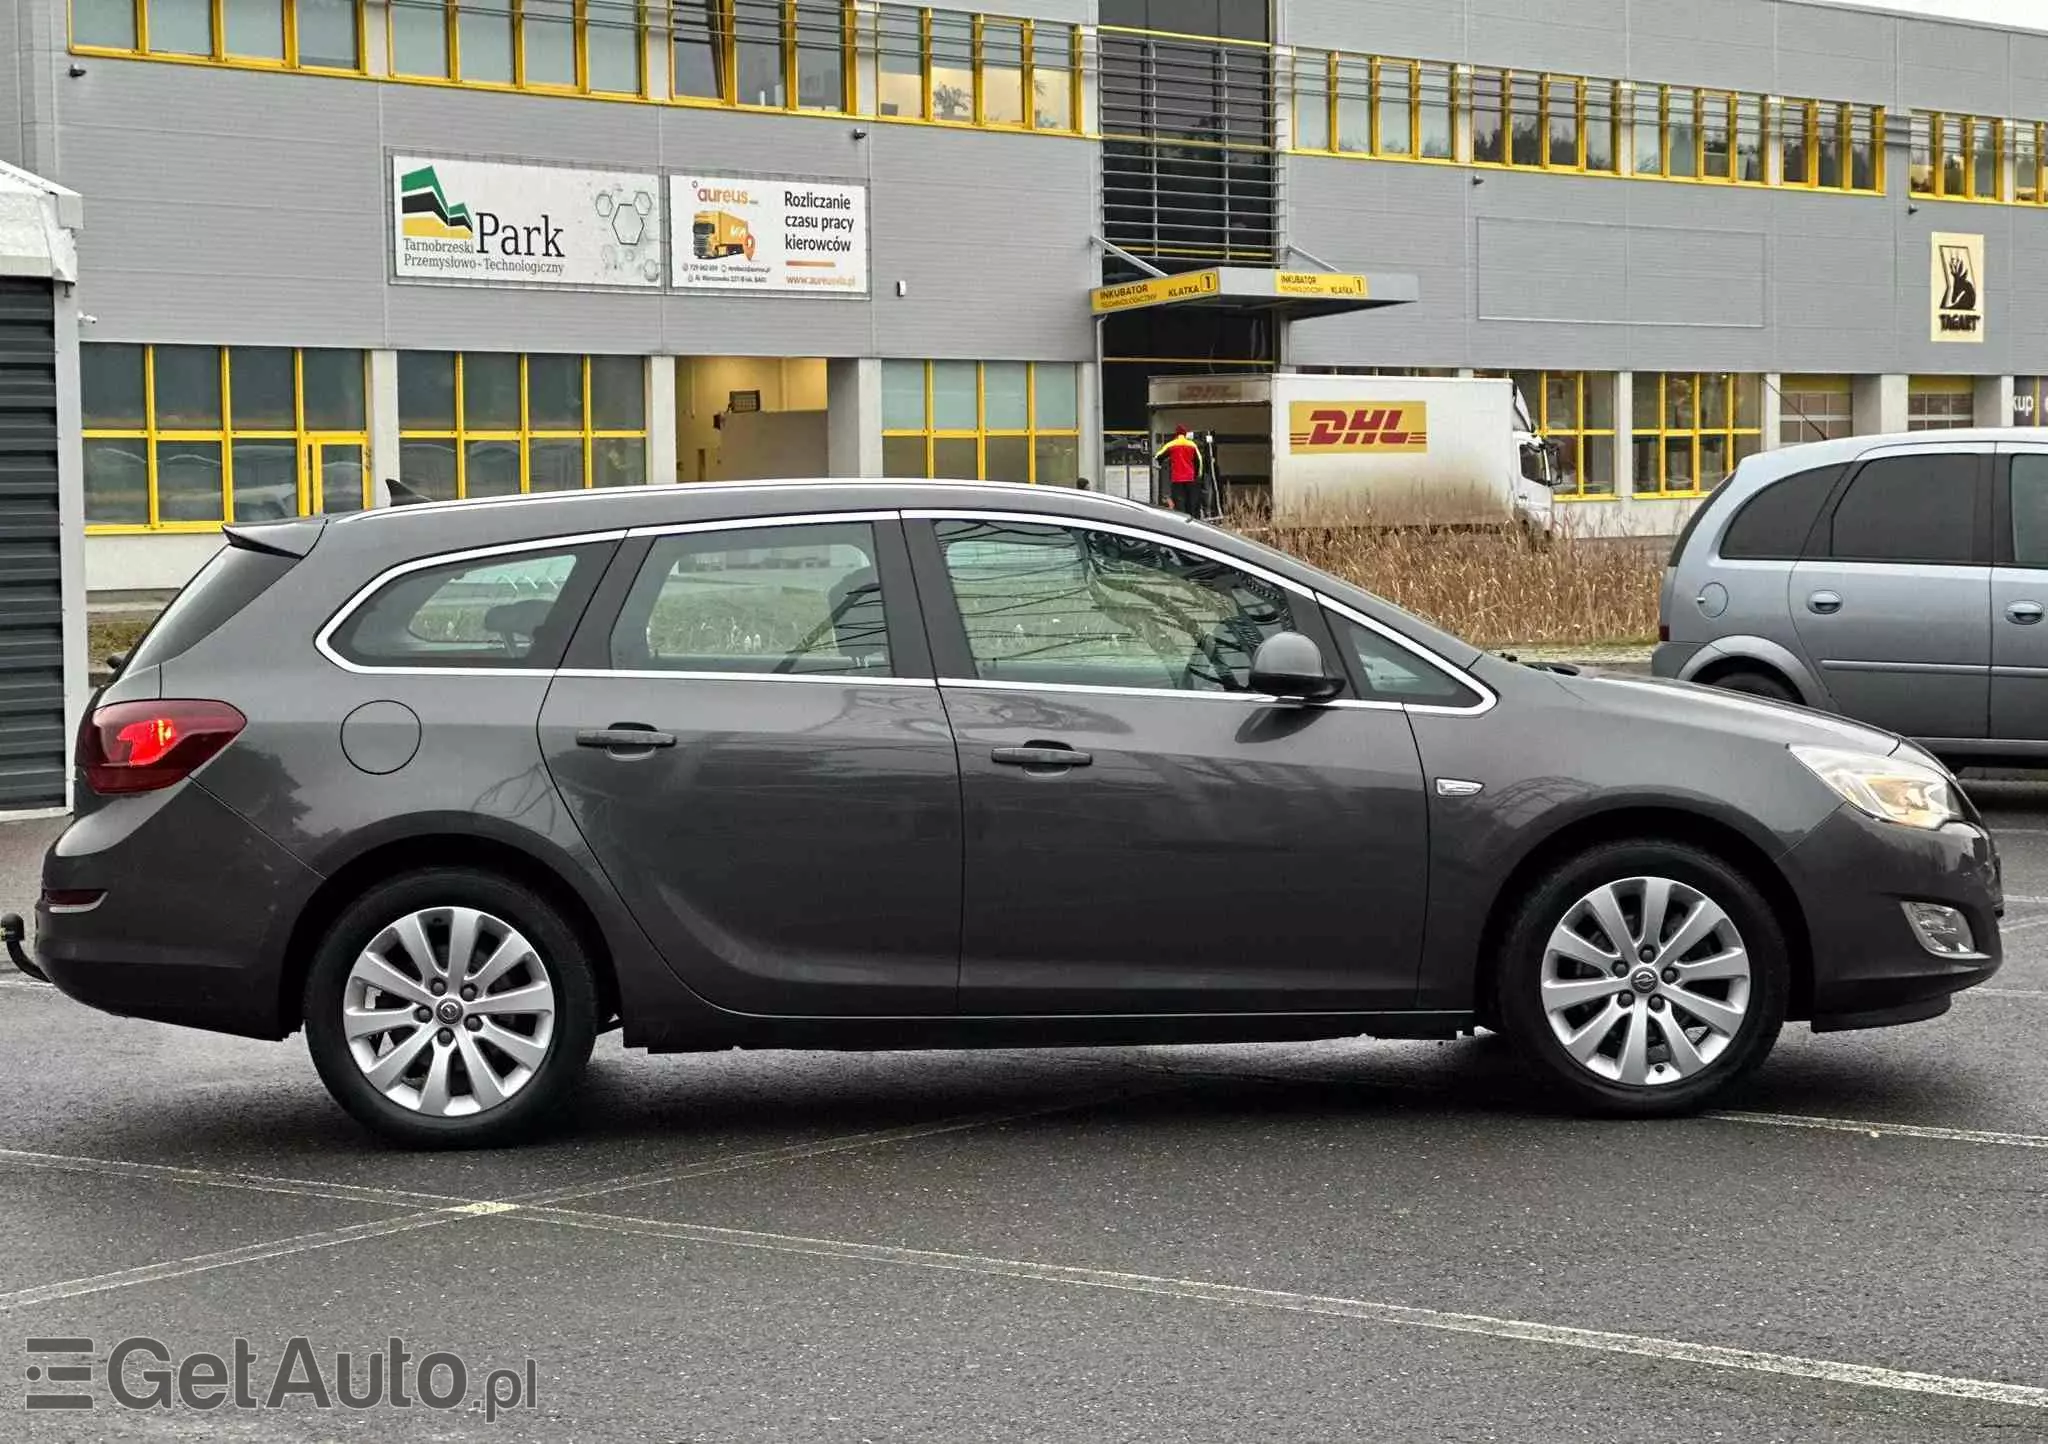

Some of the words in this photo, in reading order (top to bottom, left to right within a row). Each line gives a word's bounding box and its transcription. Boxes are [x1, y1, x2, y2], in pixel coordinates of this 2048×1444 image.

[697, 187, 749, 205] aureus
[784, 190, 851, 210] Rozliczanie
[785, 215, 818, 228] czasu
[822, 217, 854, 232] pracy
[475, 212, 566, 258] Park
[785, 233, 851, 252] kierowców
[403, 237, 474, 254] Tarnobrzeski
[1100, 283, 1149, 300] INKUBATOR
[1168, 285, 1200, 297] KLATKA
[1307, 409, 1410, 445] DHL
